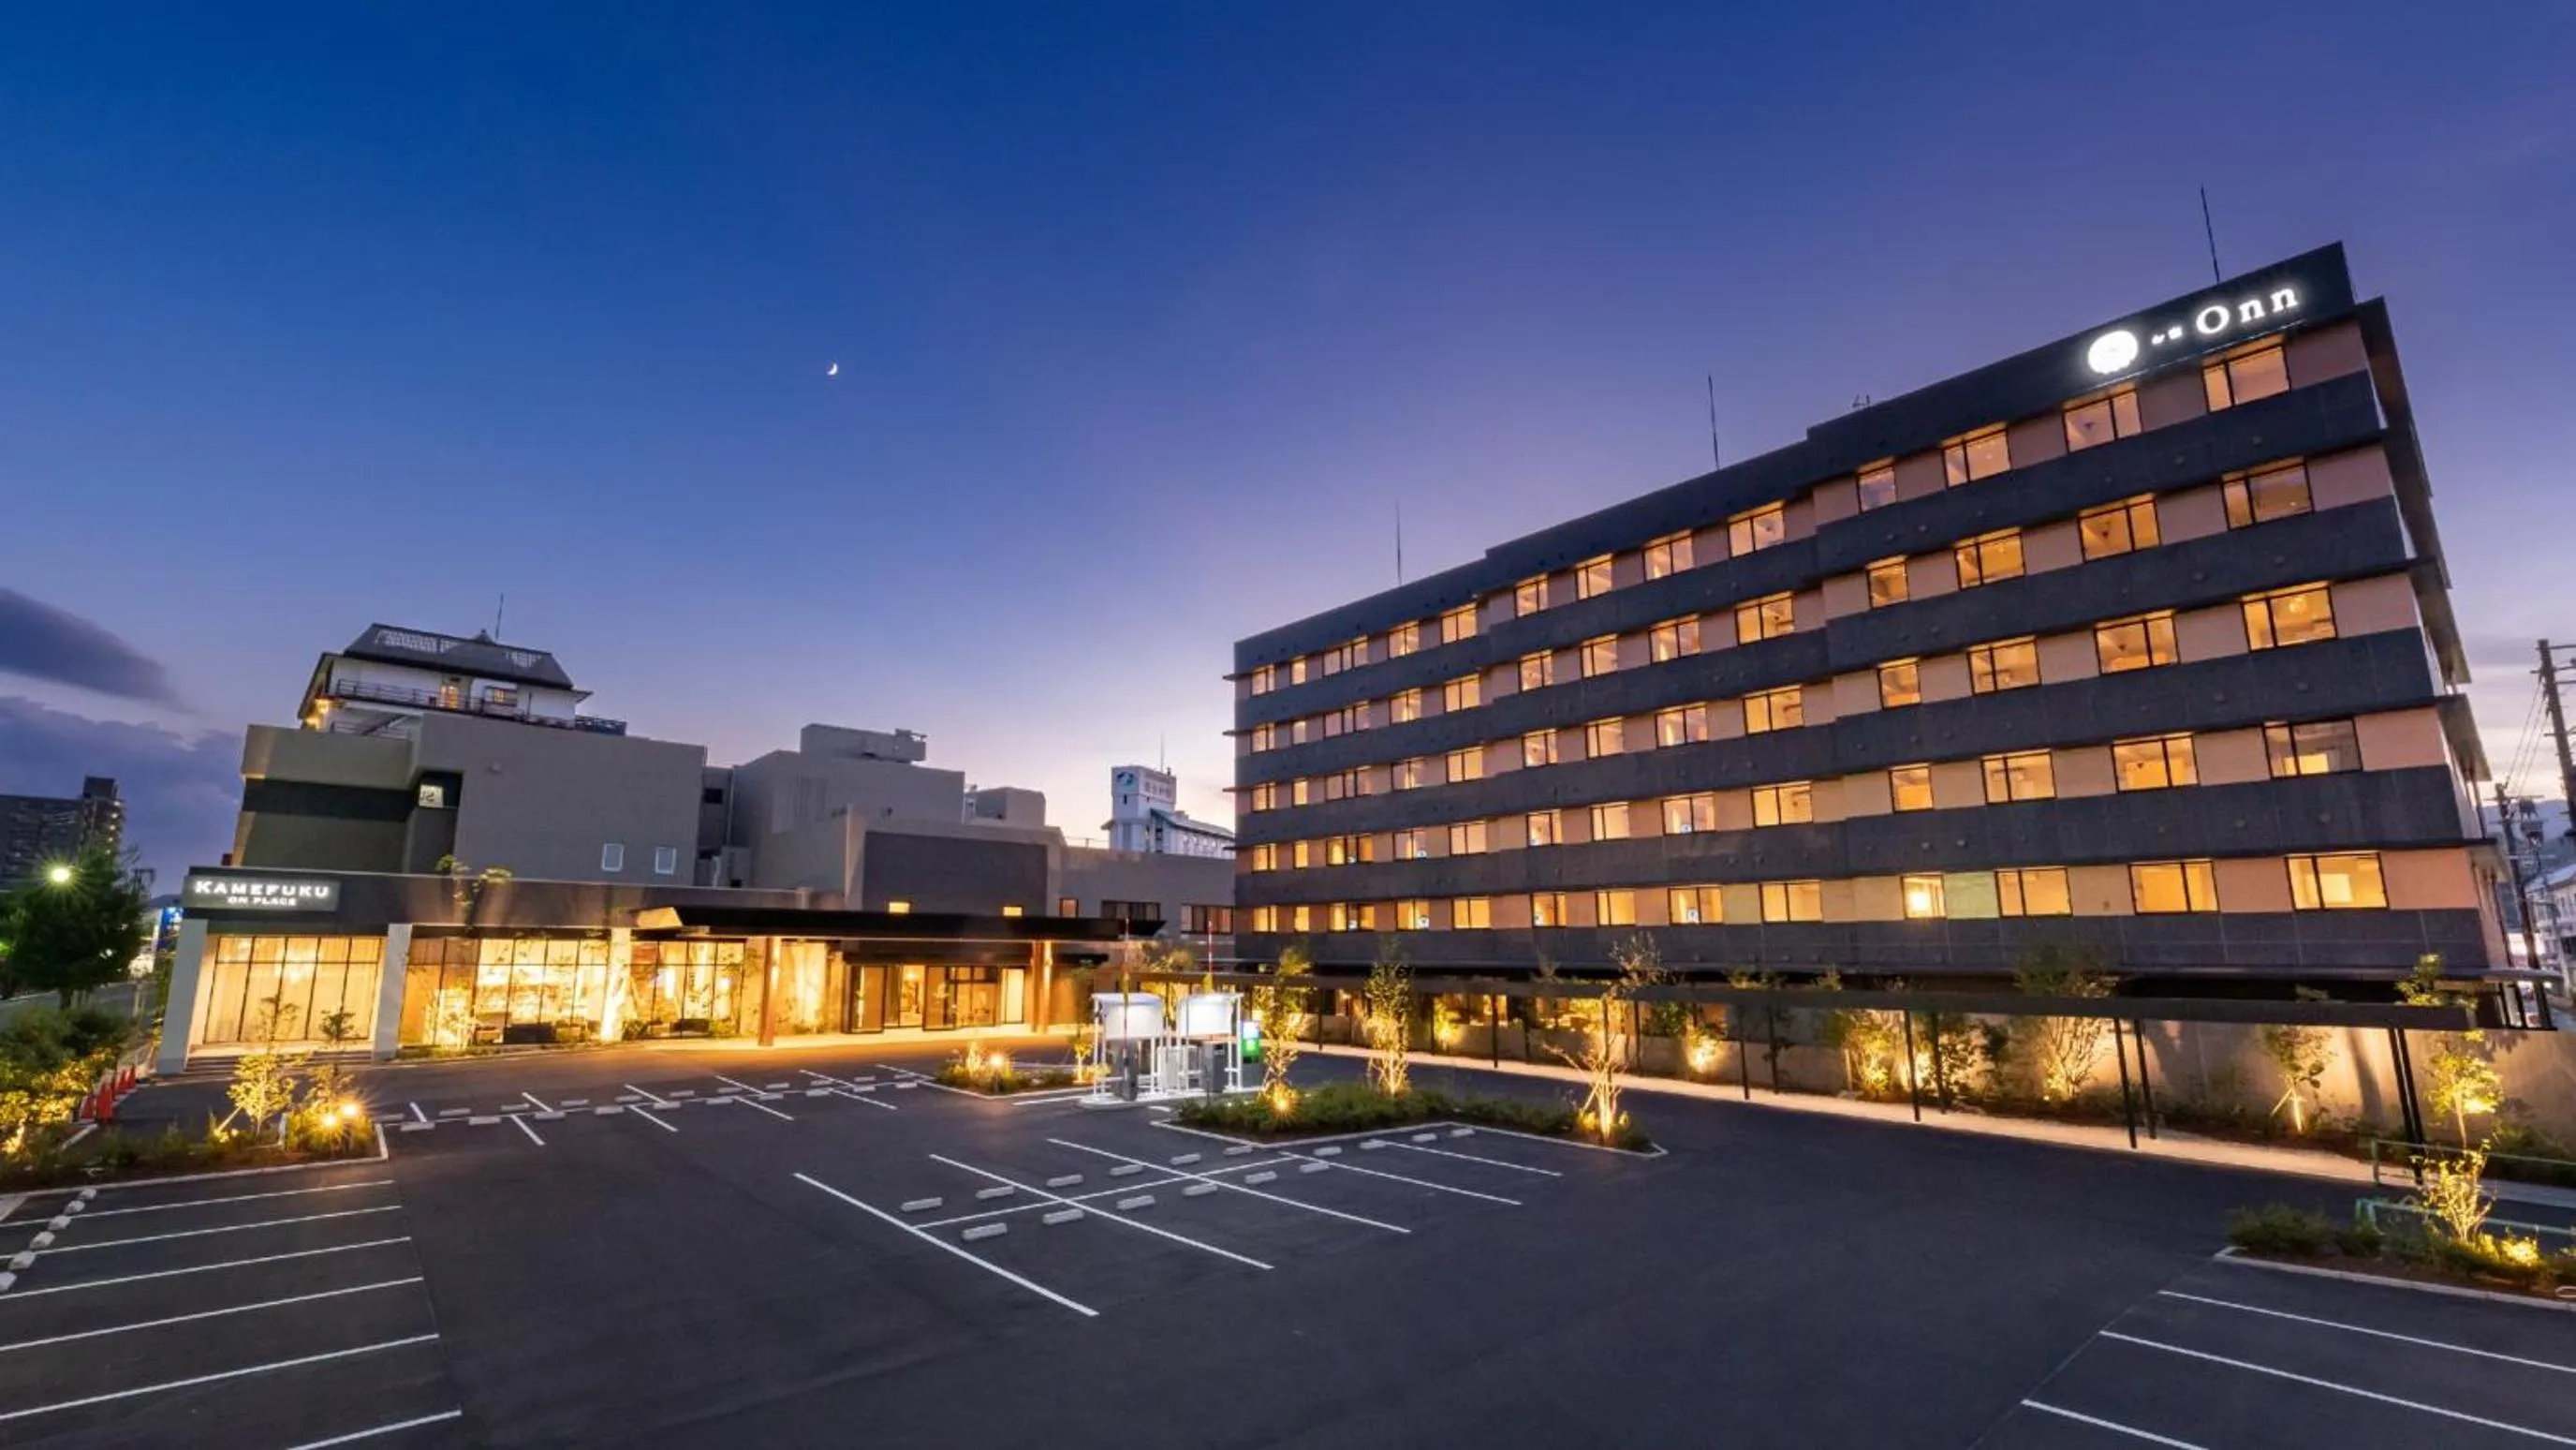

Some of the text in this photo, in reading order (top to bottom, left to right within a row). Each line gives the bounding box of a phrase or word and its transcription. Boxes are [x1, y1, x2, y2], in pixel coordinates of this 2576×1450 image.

[2195, 288, 2299, 334] Onn
[194, 880, 331, 897] KAMEFUKU
[227, 895, 298, 907] ON PLACE
